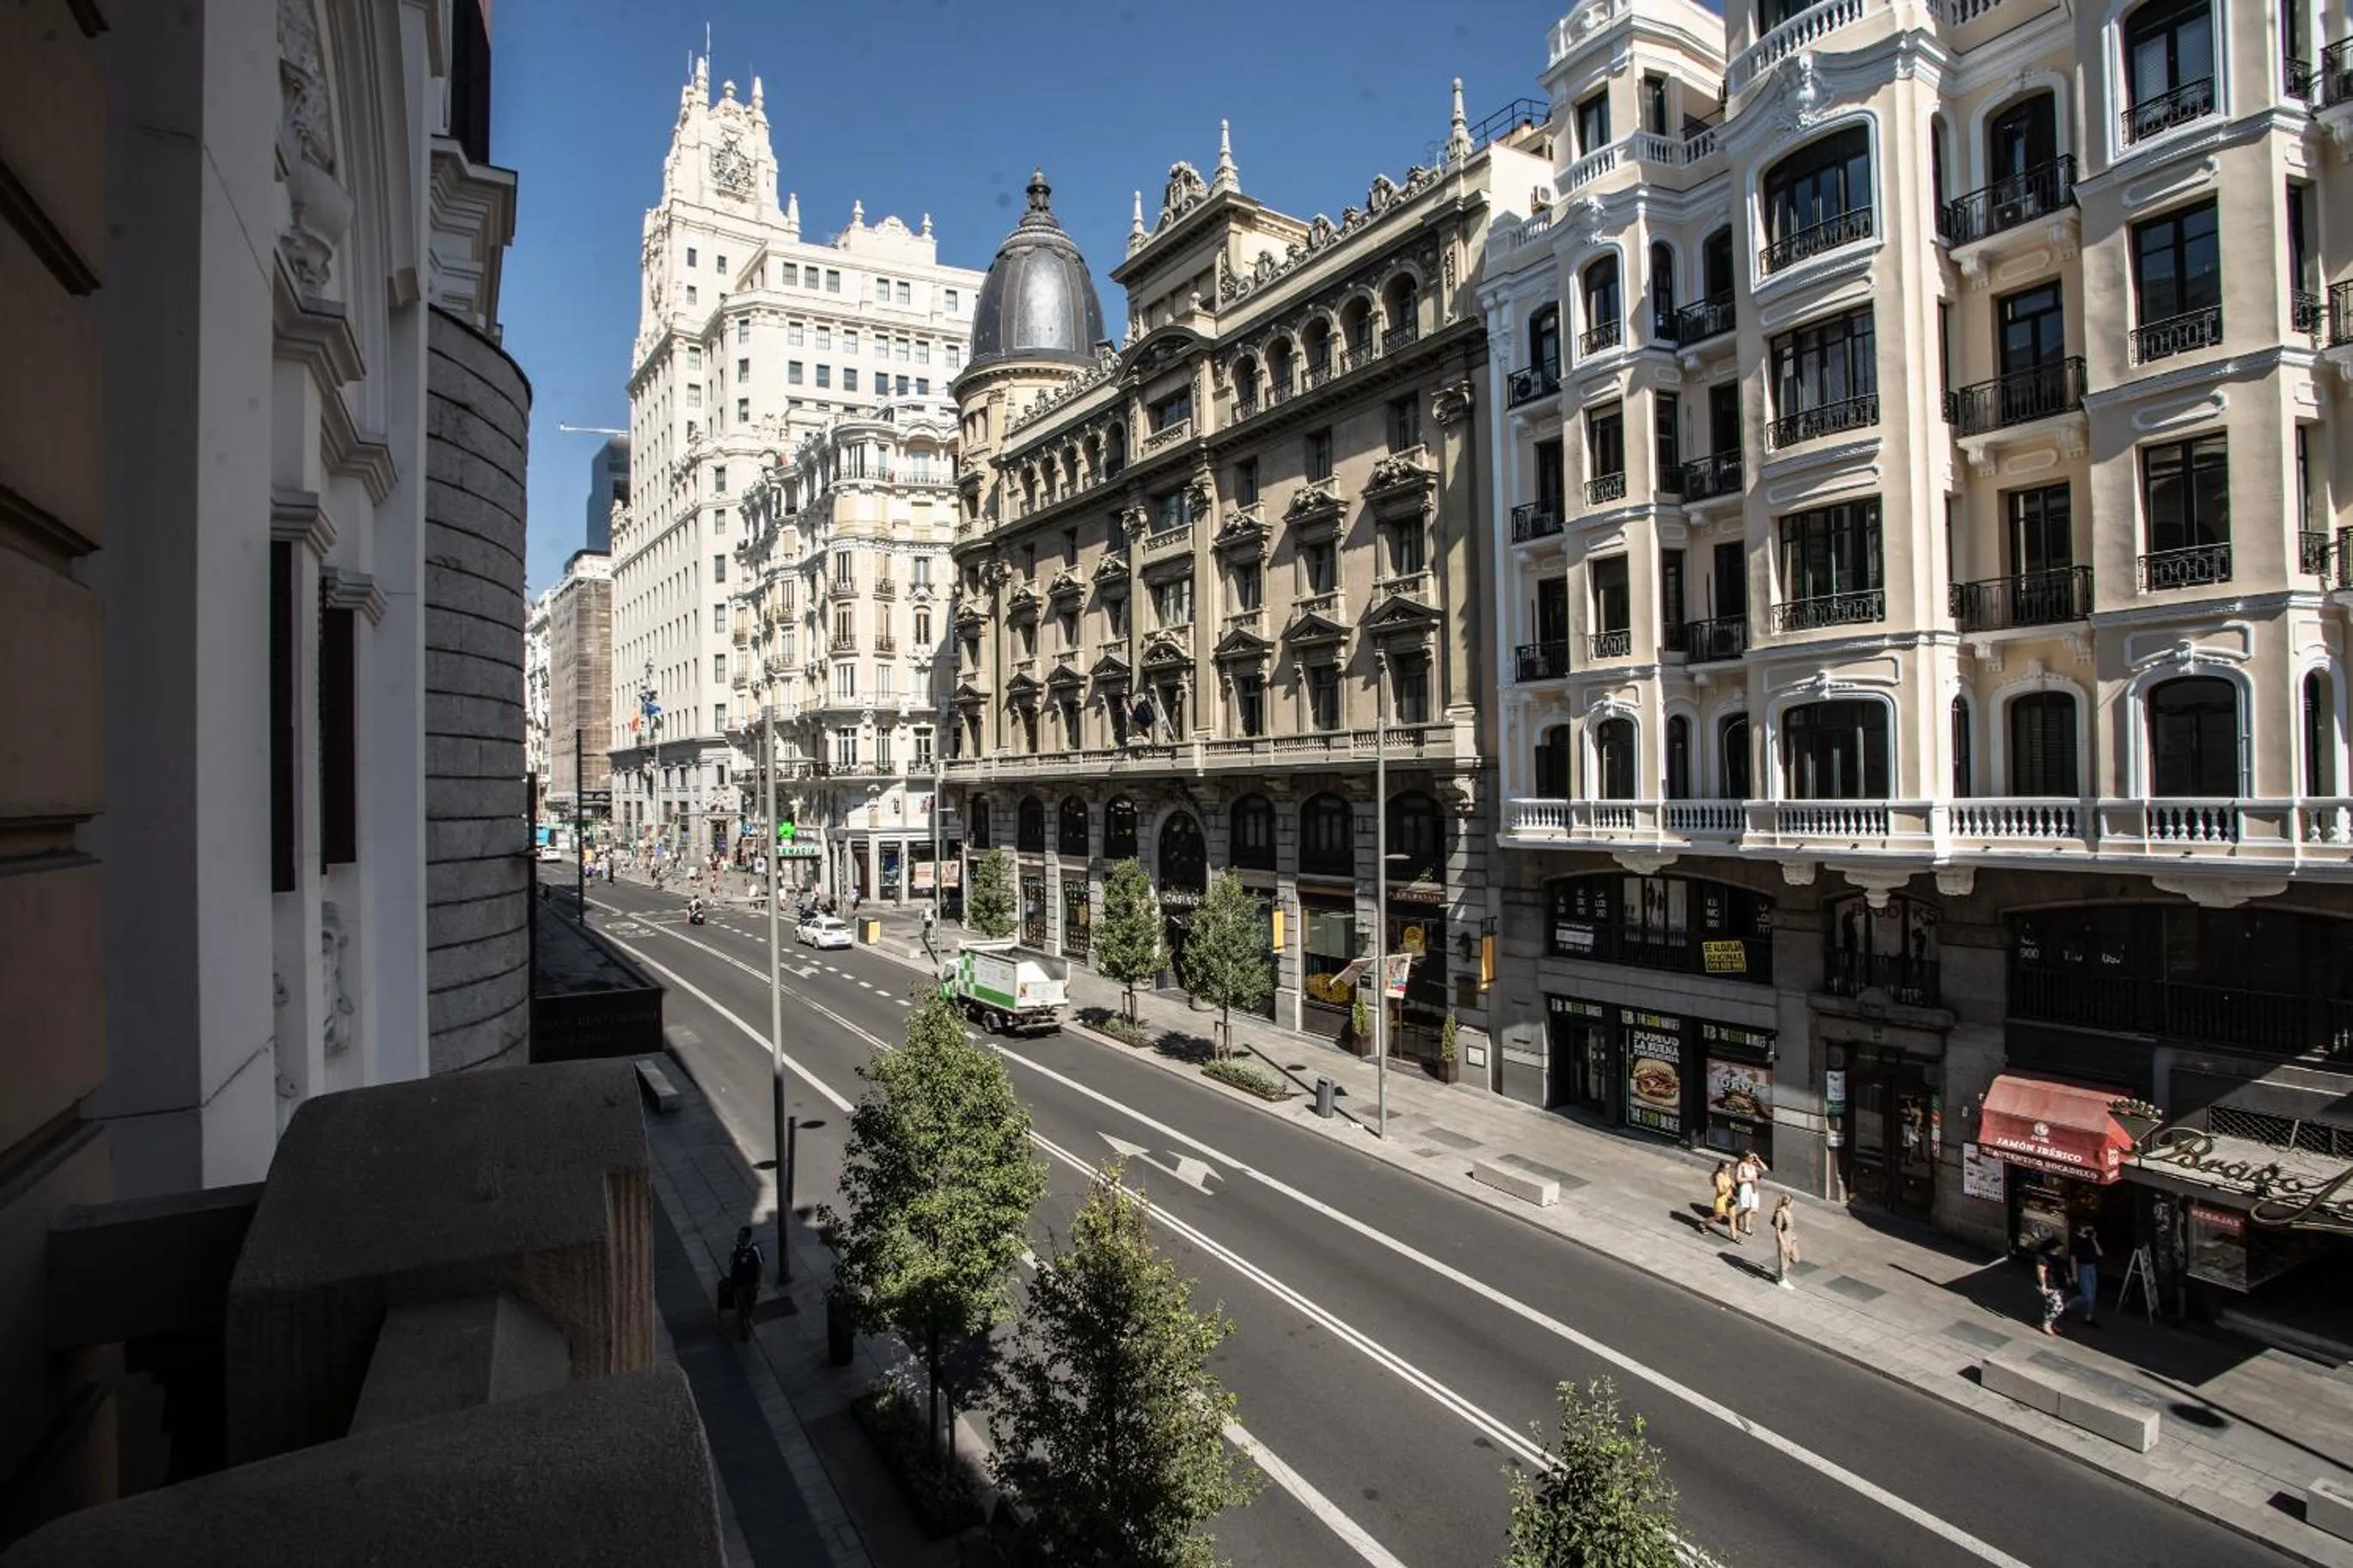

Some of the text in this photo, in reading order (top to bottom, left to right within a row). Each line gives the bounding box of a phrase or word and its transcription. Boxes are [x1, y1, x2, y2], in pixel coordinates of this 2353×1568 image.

[1164, 894, 1201, 906] CASINO
[1996, 1137, 2034, 1153] JAMÓN
[2037, 1145, 2082, 1163] IBÉRICO
